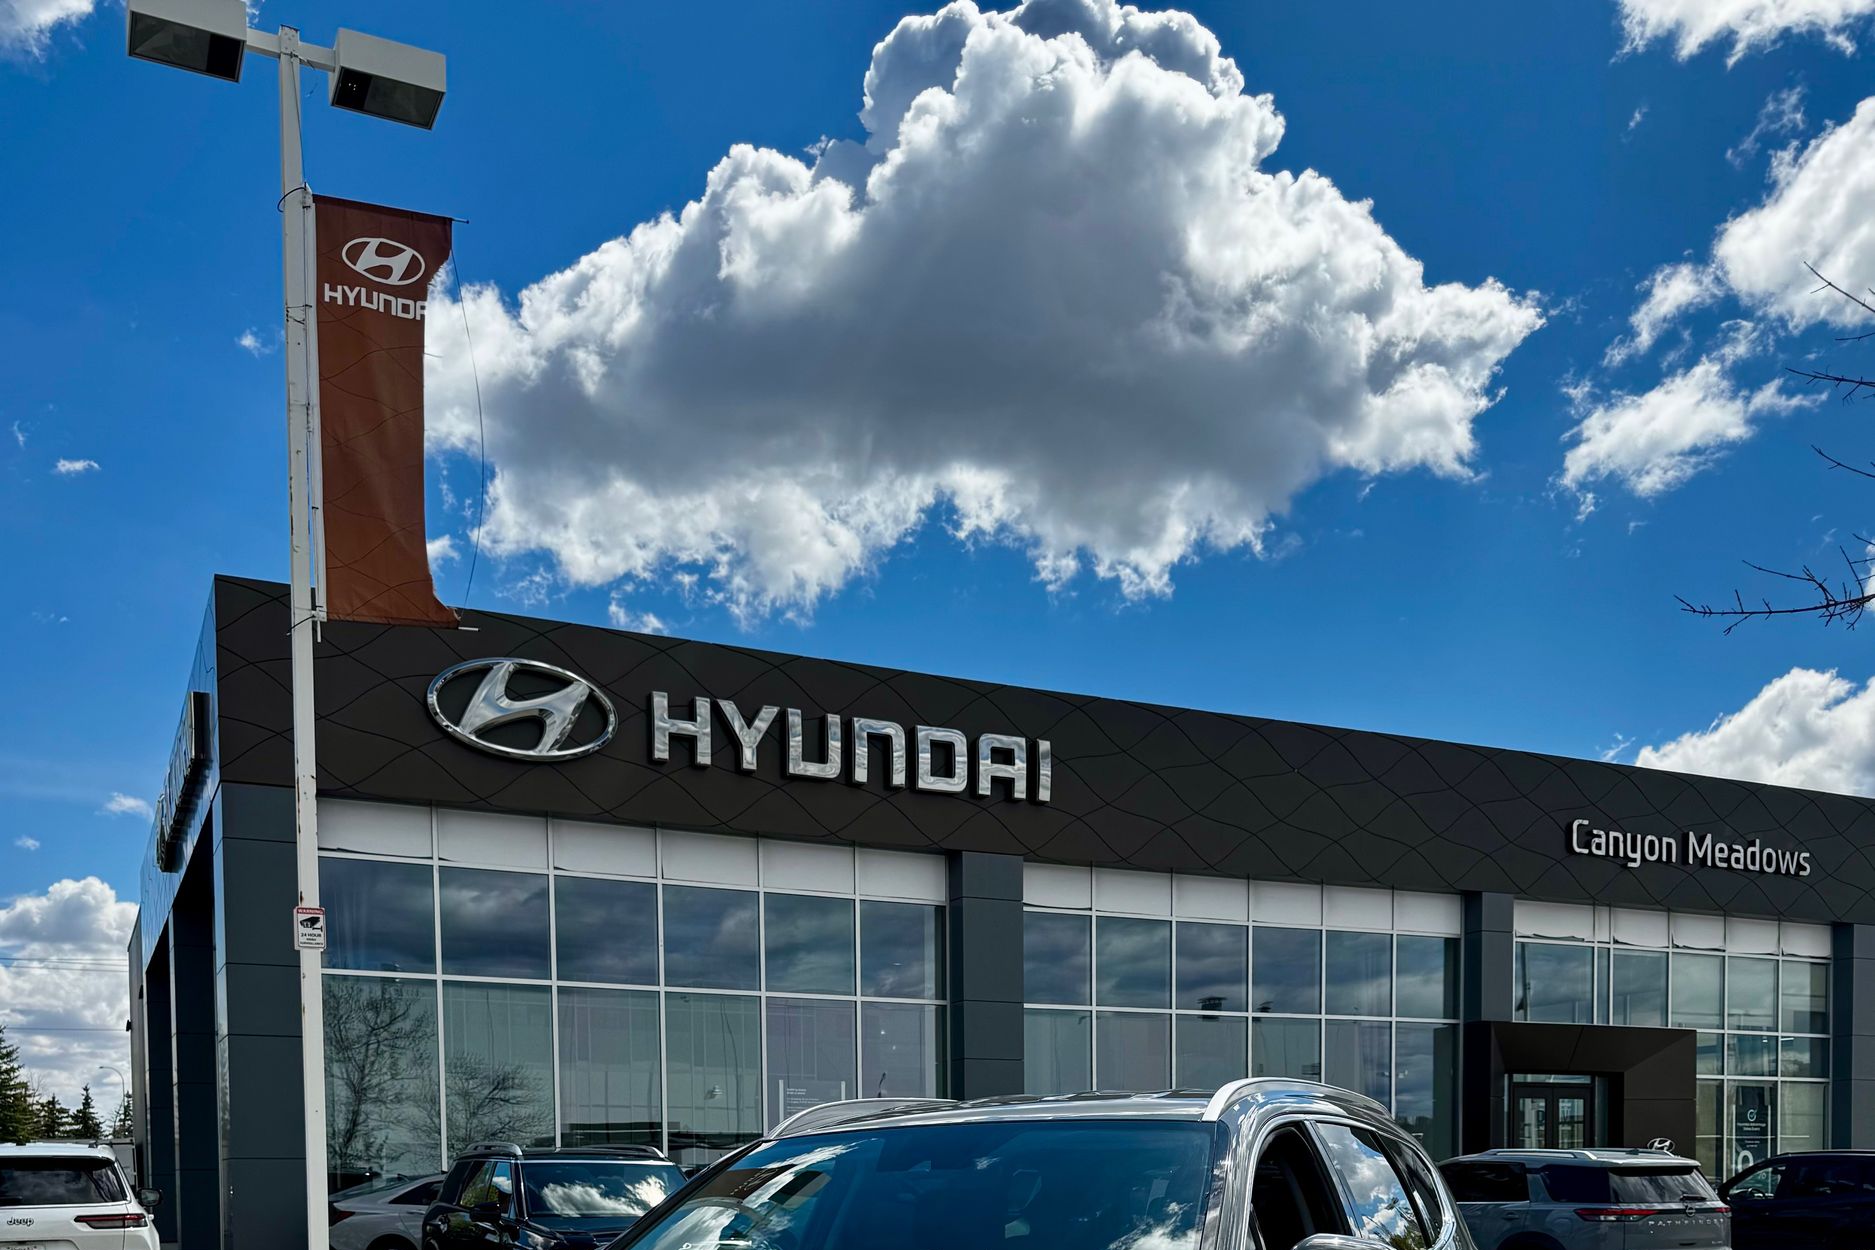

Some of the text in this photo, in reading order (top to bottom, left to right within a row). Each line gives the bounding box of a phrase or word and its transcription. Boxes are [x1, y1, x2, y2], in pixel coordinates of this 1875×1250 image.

[324, 283, 426, 321] HYUNDA
[650, 690, 1052, 802] HYUNDAI
[1571, 818, 1811, 877] Canyon Meadows
